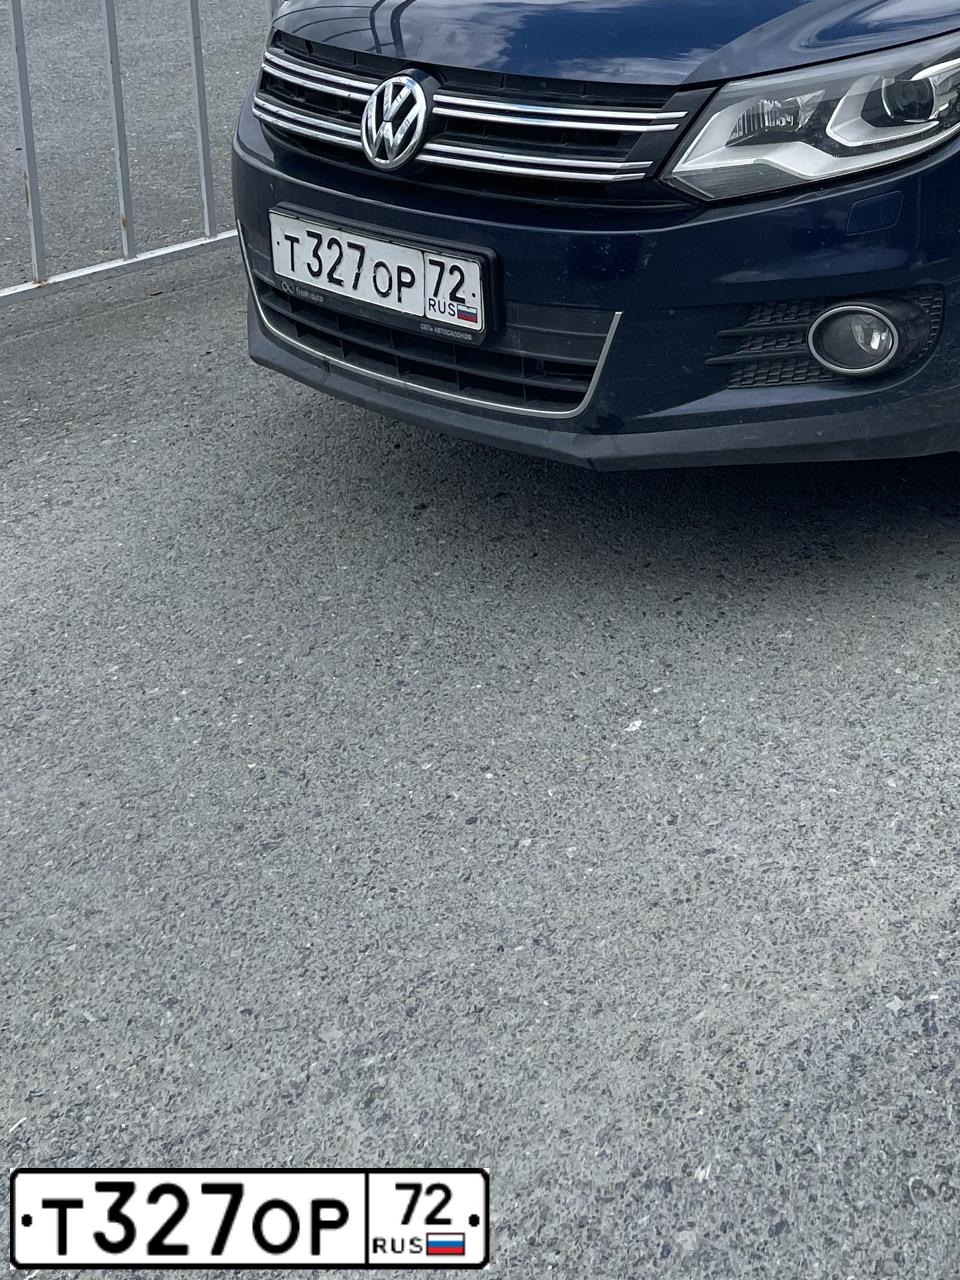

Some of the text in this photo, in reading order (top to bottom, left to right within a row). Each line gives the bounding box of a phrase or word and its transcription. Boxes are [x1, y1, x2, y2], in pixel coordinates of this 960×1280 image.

[284, 230, 466, 304] Т327ОР 72
[428, 298, 456, 317] RUS
